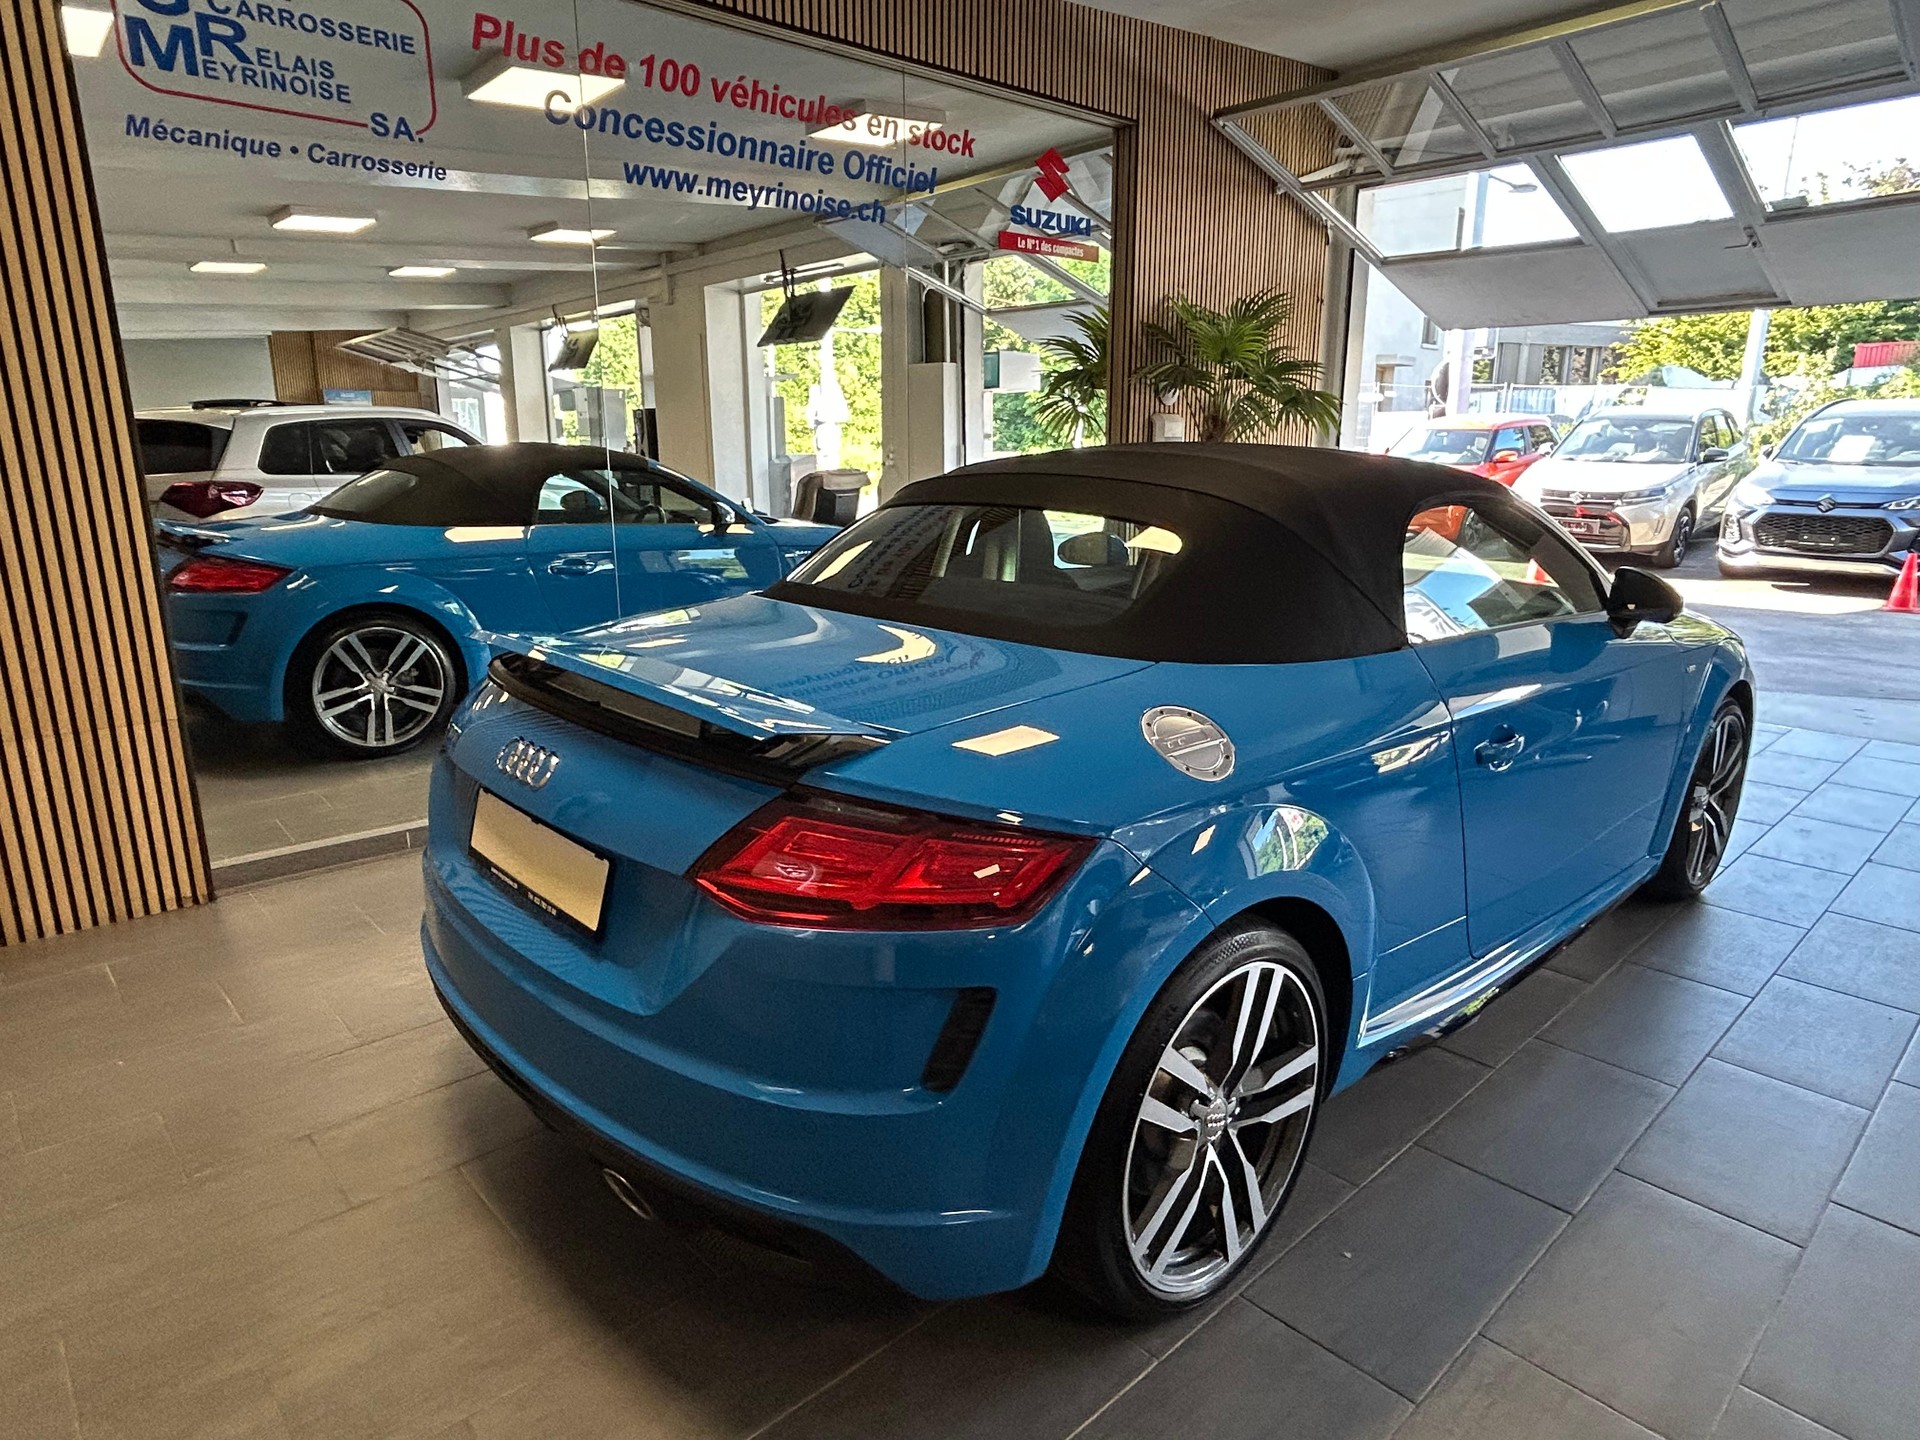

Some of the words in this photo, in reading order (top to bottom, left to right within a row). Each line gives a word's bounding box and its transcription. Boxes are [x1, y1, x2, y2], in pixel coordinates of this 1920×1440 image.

[471, 12, 566, 68] Plus
[577, 41, 627, 79] de
[639, 53, 701, 97] 100
[710, 75, 857, 131] véhicules
[867, 113, 899, 141] en
[908, 122, 976, 158] stock
[124, 113, 281, 159] Mécanique
[306, 142, 447, 181] Carrosserie
[543, 89, 835, 176] Concessionnaire
[842, 149, 938, 194] Officiel
[622, 161, 887, 225] www.meyrinoise.ch
[1010, 204, 1091, 237] SUZUKI
[1017, 236, 1027, 249] Le
[1041, 240, 1052, 253] des
